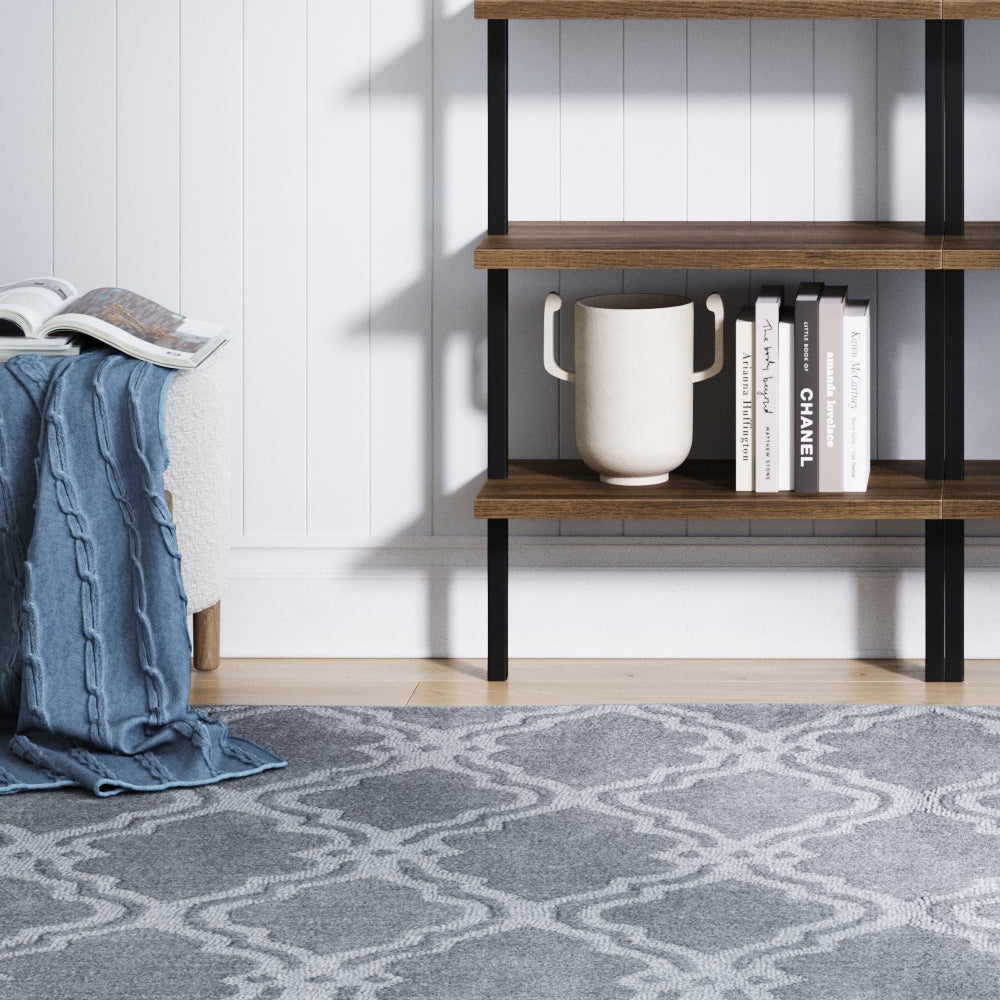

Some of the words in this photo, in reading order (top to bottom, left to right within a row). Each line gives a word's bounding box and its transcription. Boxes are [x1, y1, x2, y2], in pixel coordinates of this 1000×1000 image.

[762, 346, 776, 371] body
[851, 331, 861, 357] Karen
[743, 352, 752, 396] Arianna
[803, 363, 809, 372] OF
[826, 351, 836, 397] amanda
[848, 361, 861, 410] McCartney
[756, 376, 774, 414] beyond
[740, 400, 752, 462] Huffington
[799, 387, 814, 468] CHANEL
[826, 400, 837, 448] lovelace
